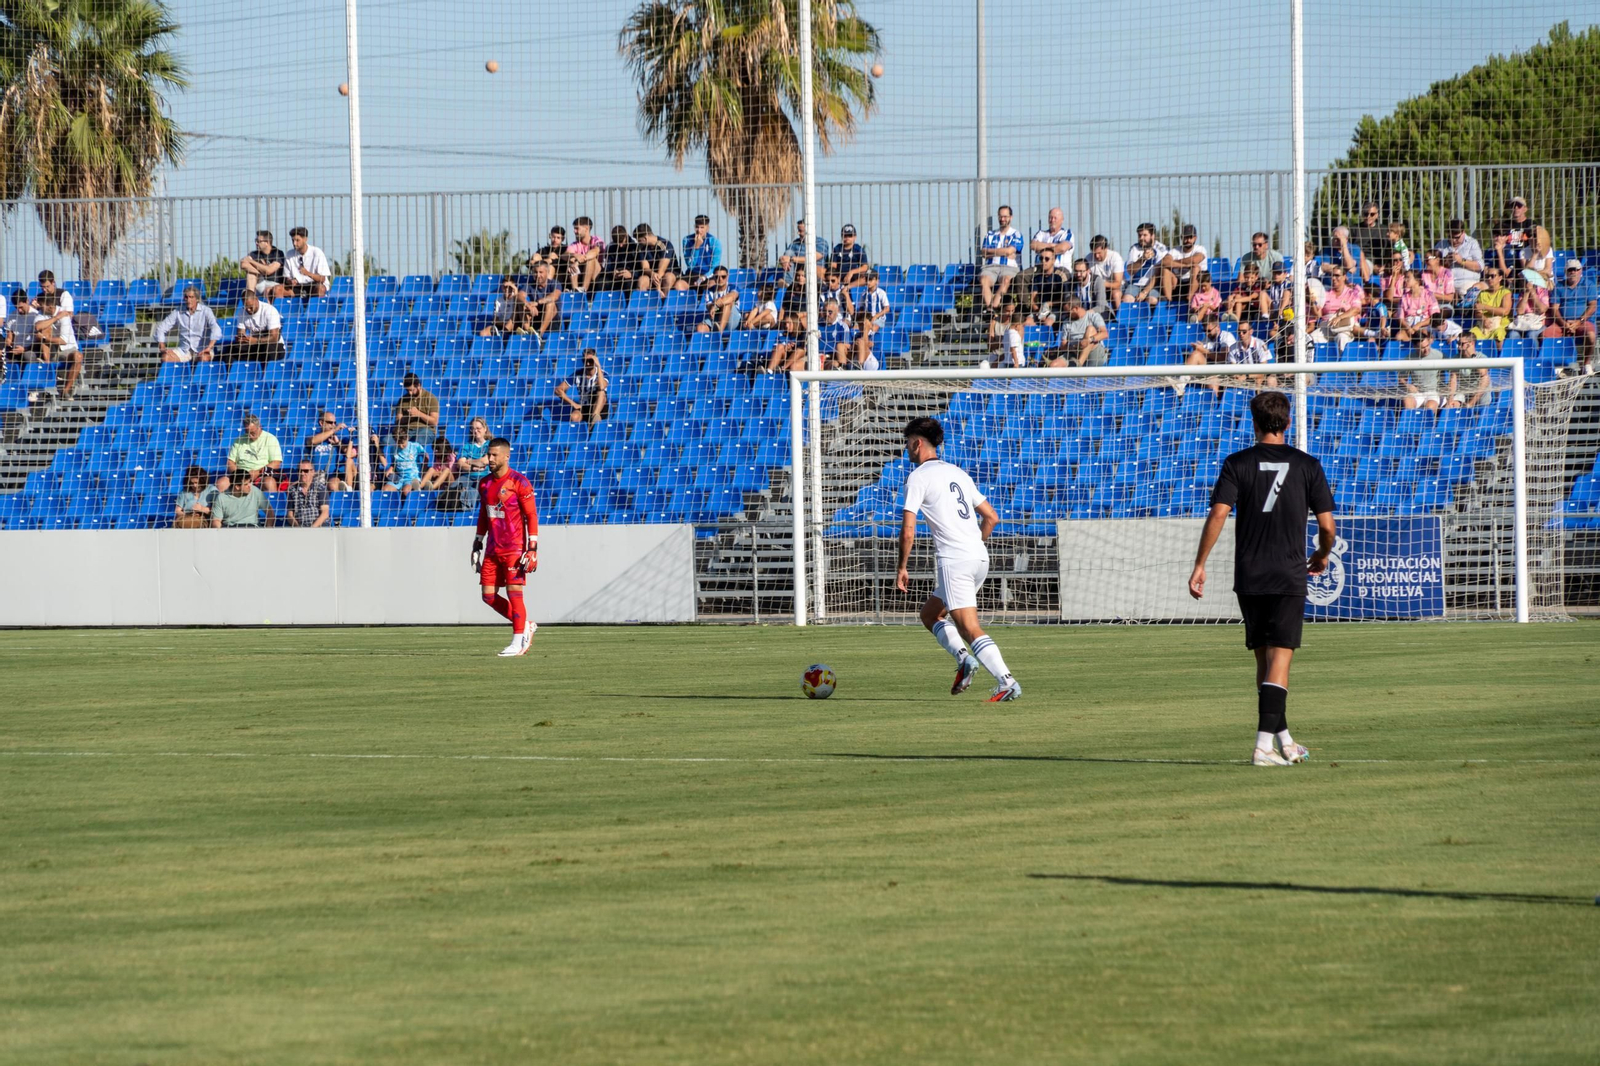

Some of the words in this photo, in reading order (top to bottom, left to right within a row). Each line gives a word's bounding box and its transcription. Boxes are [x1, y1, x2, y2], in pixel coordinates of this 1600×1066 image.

[1259, 461, 1290, 513] 7
[949, 481, 971, 520] 3
[1357, 555, 1441, 570] DIPUTACIÓN
[1357, 571, 1440, 584] PROVINCIAL
[1371, 585, 1424, 597] HUELVA
